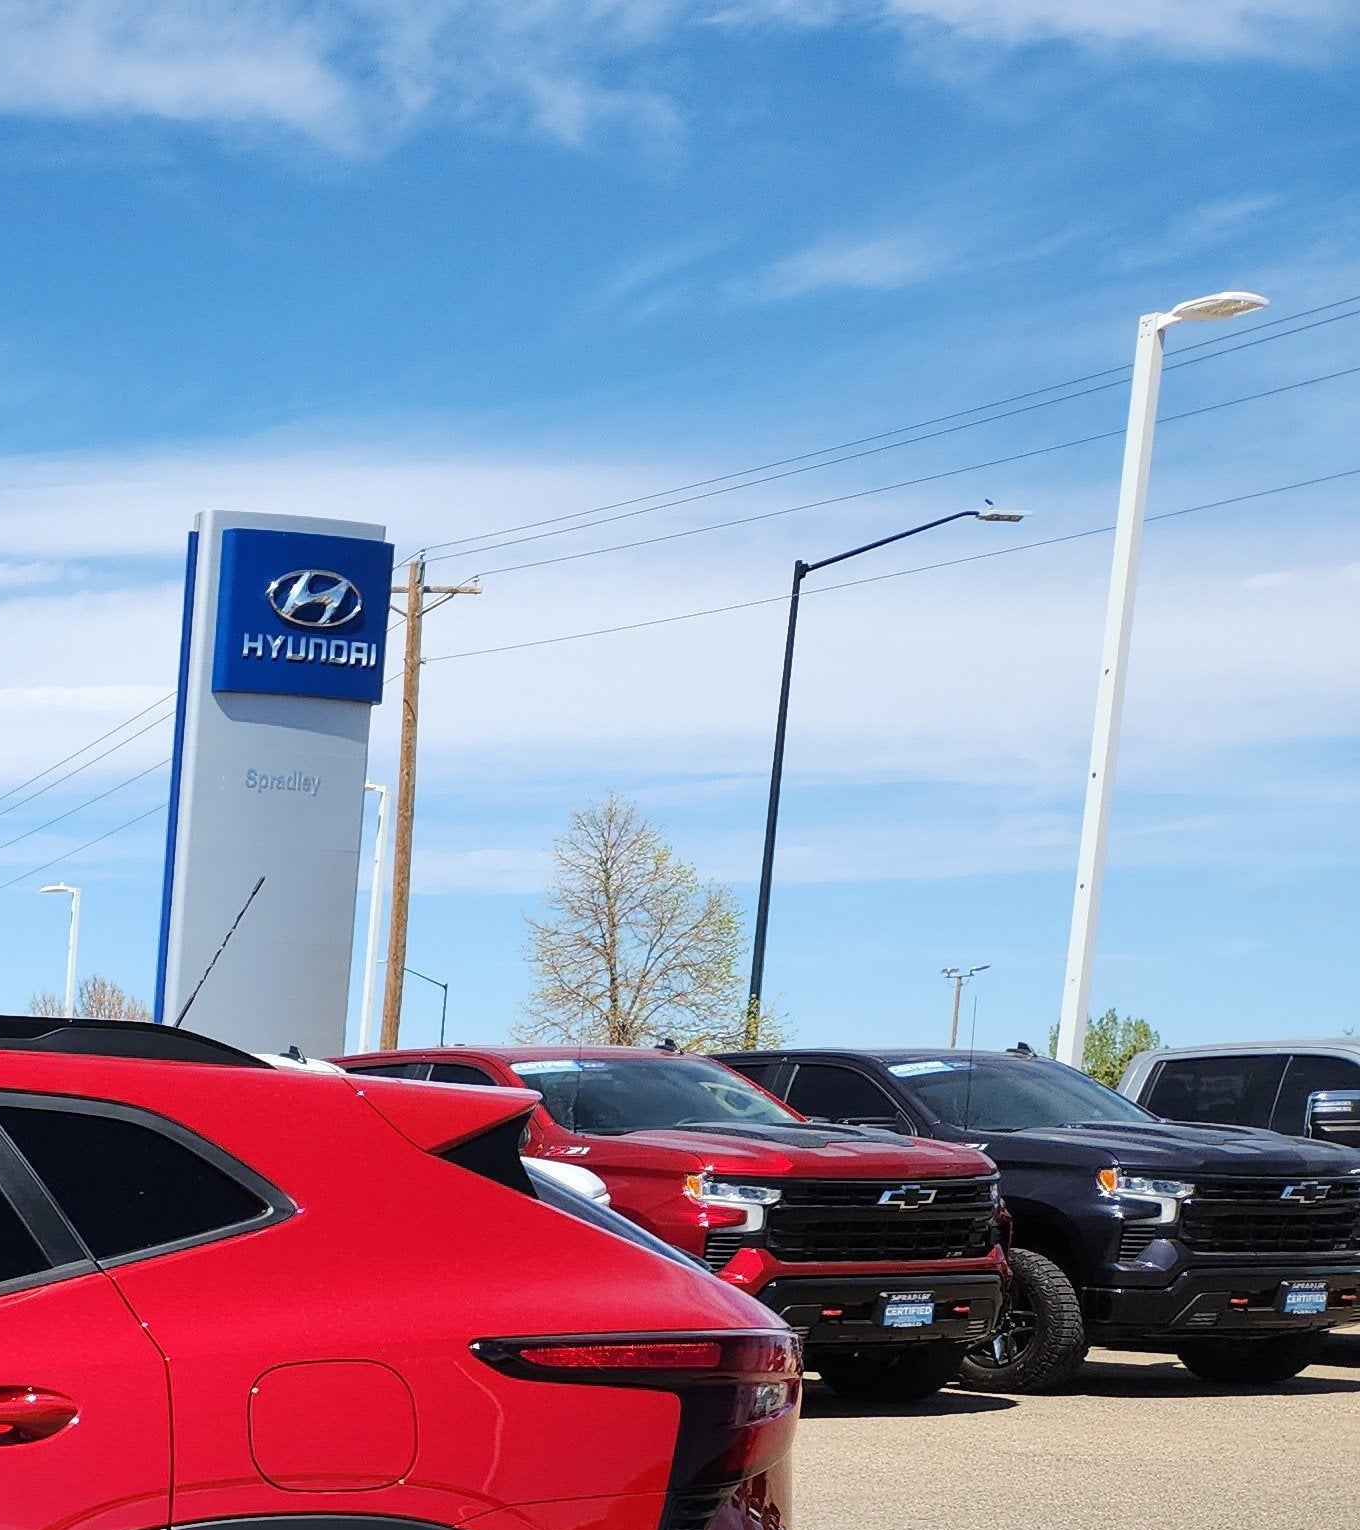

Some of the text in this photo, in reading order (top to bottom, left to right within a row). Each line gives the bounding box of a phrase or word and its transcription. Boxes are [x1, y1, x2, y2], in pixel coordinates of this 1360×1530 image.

[242, 632, 377, 667] HYUNDAI
[244, 768, 321, 797] Spradley
[886, 1306, 932, 1316] CERTIFIED
